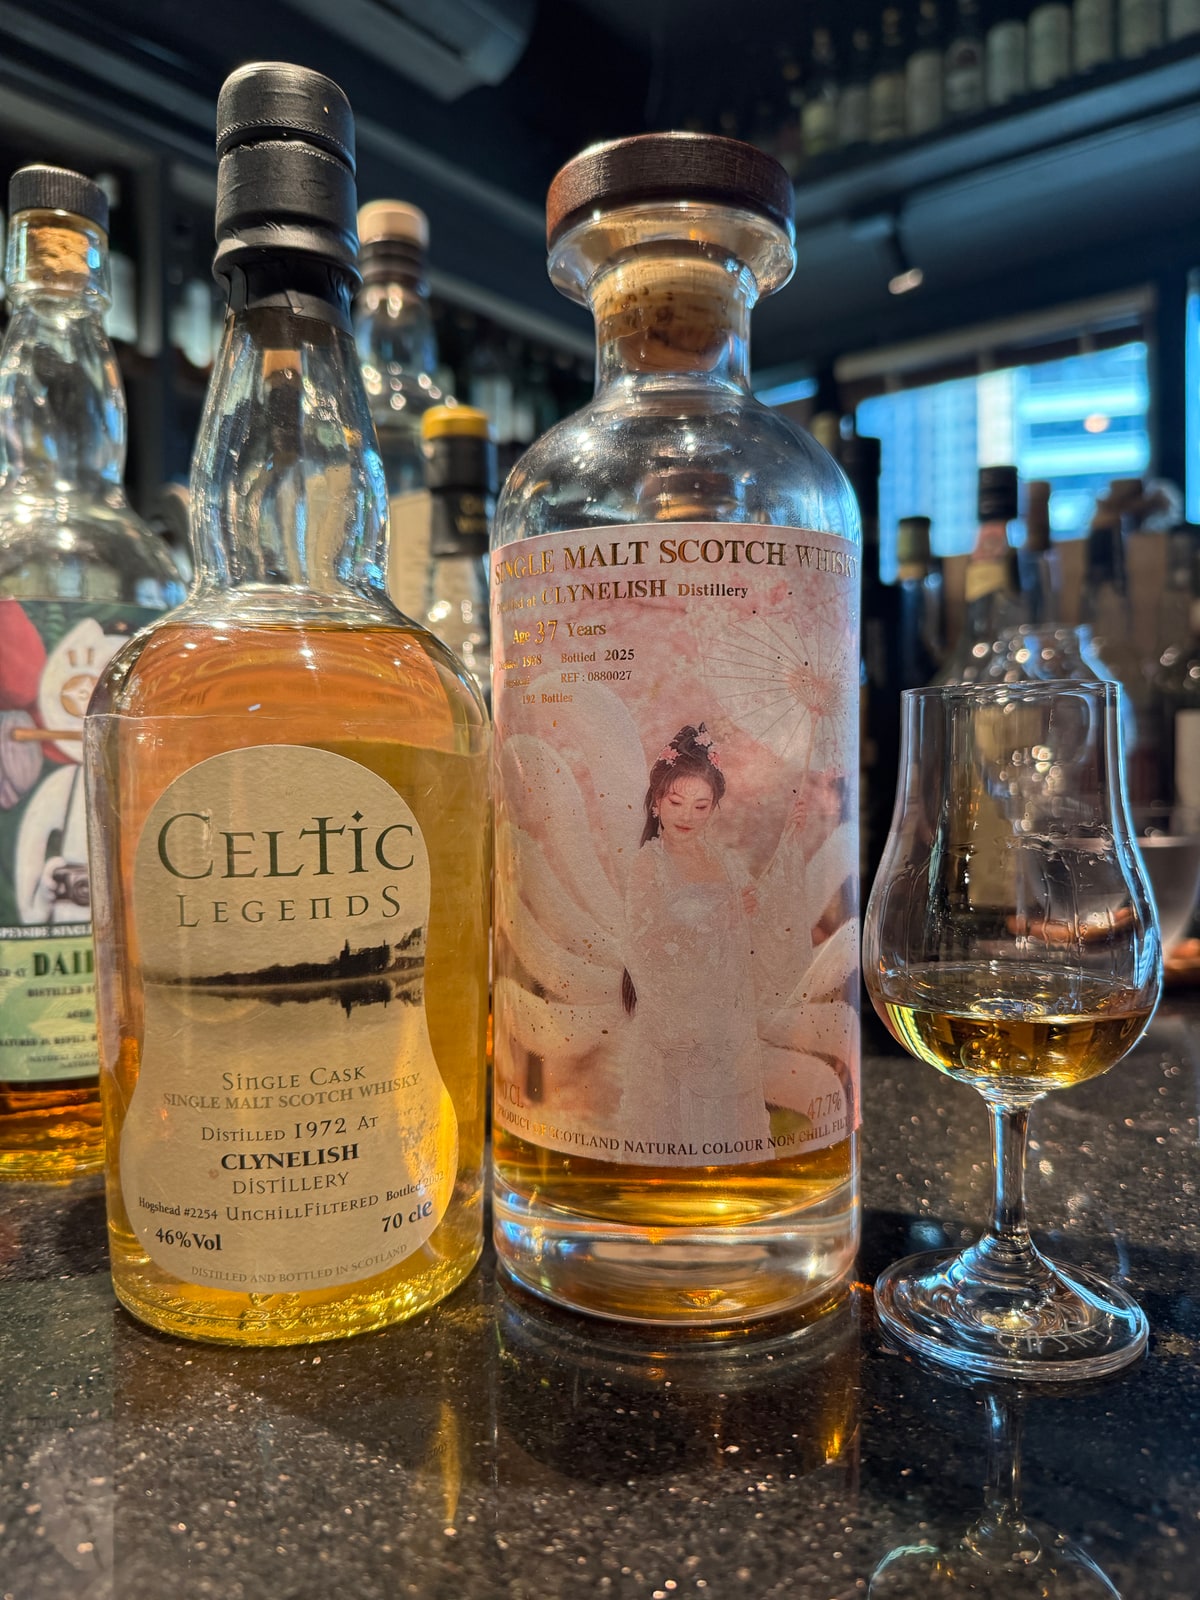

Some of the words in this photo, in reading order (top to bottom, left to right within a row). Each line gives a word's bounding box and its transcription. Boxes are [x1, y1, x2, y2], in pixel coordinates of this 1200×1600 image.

[495, 549, 555, 585] SINGLE
[563, 540, 650, 571] MALT
[658, 539, 787, 567] SCOTCH
[526, 594, 537, 608] at
[541, 579, 667, 606] CLYNELISH
[677, 583, 749, 599] Distillery
[512, 629, 531, 645] Age
[534, 619, 558, 644] 37
[565, 622, 607, 638] Years
[560, 651, 597, 664] Bottled
[604, 648, 636, 661] 2025
[522, 694, 536, 705] 192
[541, 693, 573, 704] Bottles
[53, 925, 92, 936] SINGL
[310, 1066, 367, 1086] CASK
[163, 1092, 220, 1109] SINGLE
[225, 1096, 274, 1110] MALT
[278, 1088, 353, 1108] SCOTCH
[360, 1072, 420, 1098] WHISKY
[509, 1083, 524, 1108] CL
[806, 1089, 842, 1119] 47.7%
[294, 1117, 347, 1139] 1972
[357, 1115, 379, 1132] AT
[498, 1105, 530, 1130] PRODUCT
[532, 1122, 547, 1136] OF
[549, 1126, 620, 1151] SCOTLAND
[624, 1140, 698, 1155] NATURAL
[702, 1138, 764, 1155] COLOUR
[767, 1133, 795, 1149] NON
[799, 1124, 831, 1143] CHILL
[221, 1142, 360, 1171] CLYNELISH
[139, 1196, 181, 1216] Hogshead
[183, 1207, 218, 1220] #2254
[386, 1179, 422, 1202] Bottled
[381, 1212, 403, 1233] 70
[191, 1265, 247, 1282] DISTILLED
[250, 1274, 276, 1283] AND
[279, 1267, 333, 1282] BOTTLED
[335, 1264, 349, 1275] IN
[351, 1243, 408, 1271] SCOTLAND
